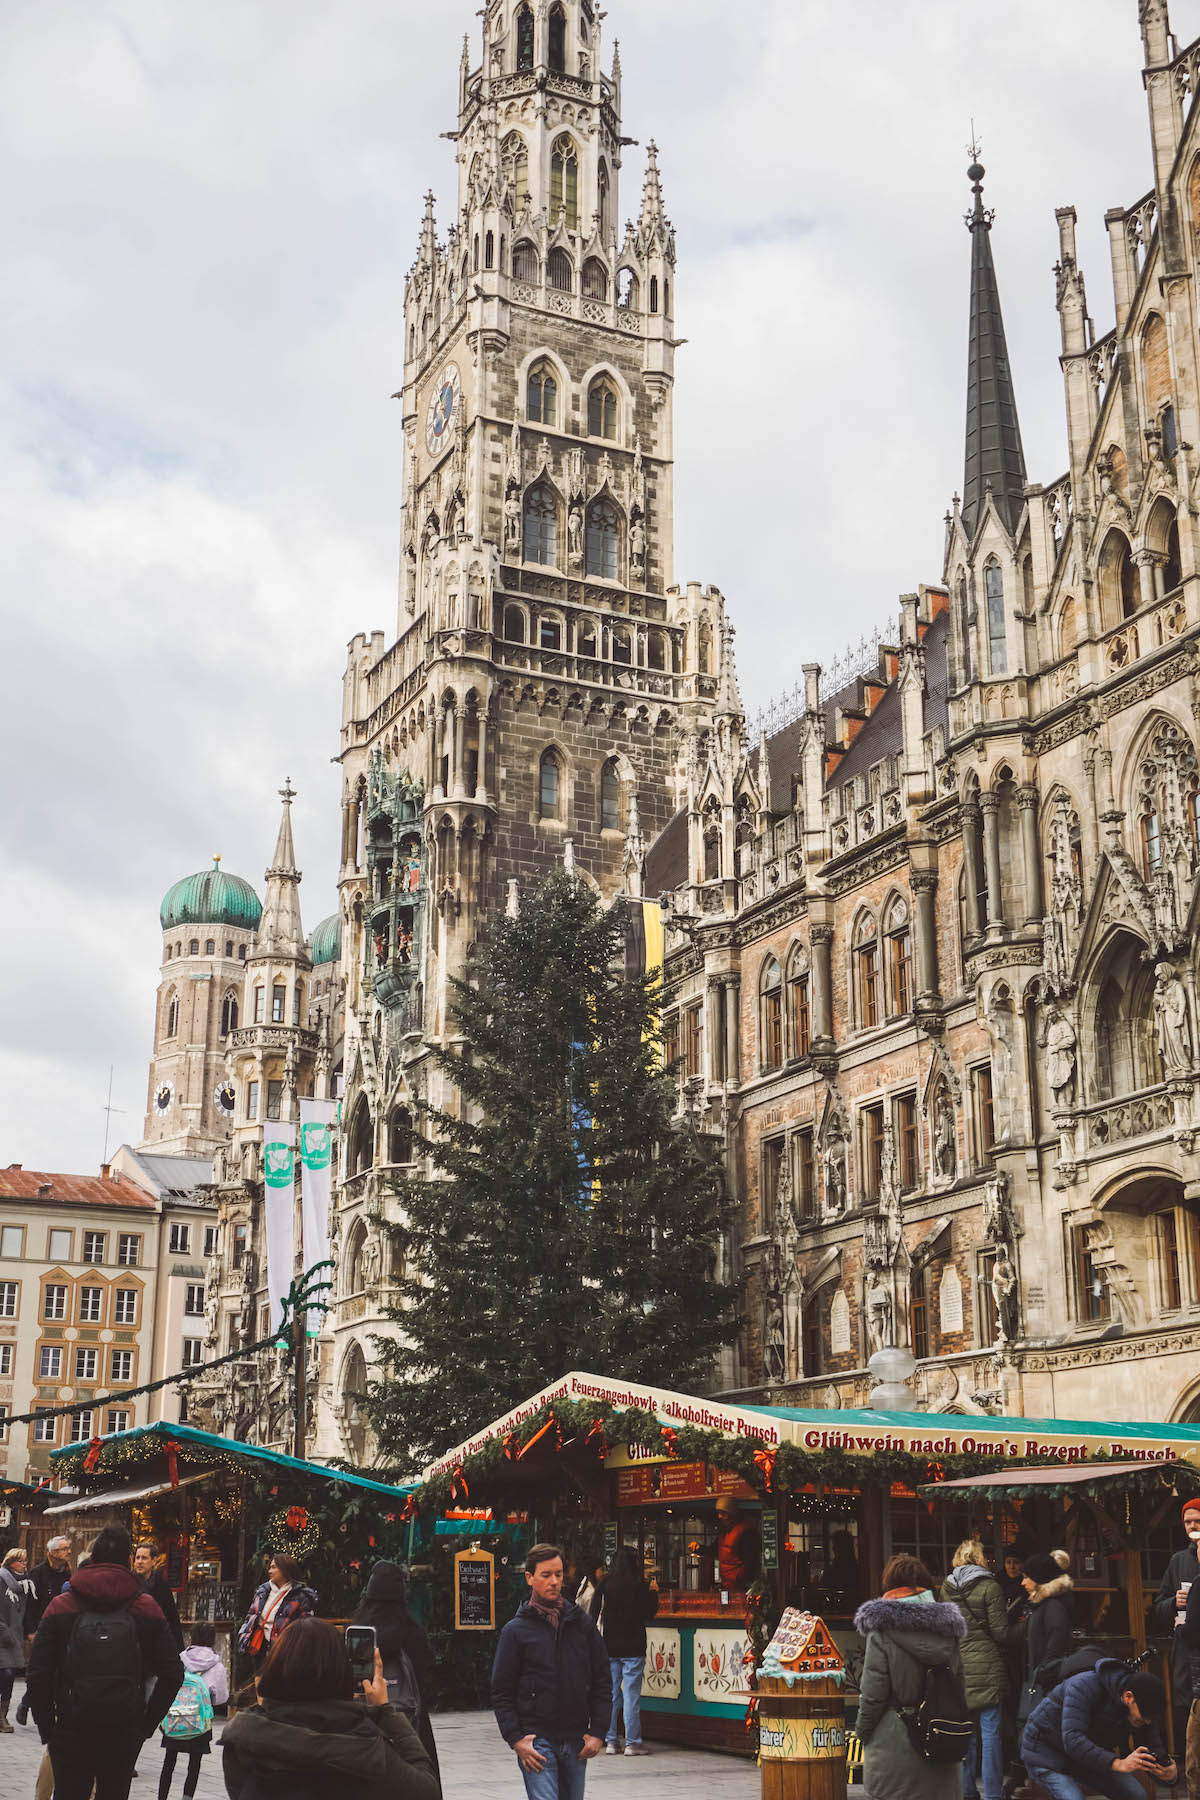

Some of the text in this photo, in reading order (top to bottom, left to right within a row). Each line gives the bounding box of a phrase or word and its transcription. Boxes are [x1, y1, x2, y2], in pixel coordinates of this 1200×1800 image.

[430, 1453, 462, 1478] Glühwein
[462, 1446, 468, 1458] &
[468, 1430, 494, 1455] Punsch
[496, 1417, 515, 1438] nach
[540, 1383, 569, 1407] Rezept
[571, 1377, 778, 1444] Feuerzangenbowle alkoholfreier Punsch
[804, 1430, 905, 1452] Glühwein
[909, 1437, 957, 1453] nach
[1024, 1440, 1089, 1462] Rezept
[1110, 1443, 1177, 1461] Punsch
[813, 1728, 829, 1747] für
